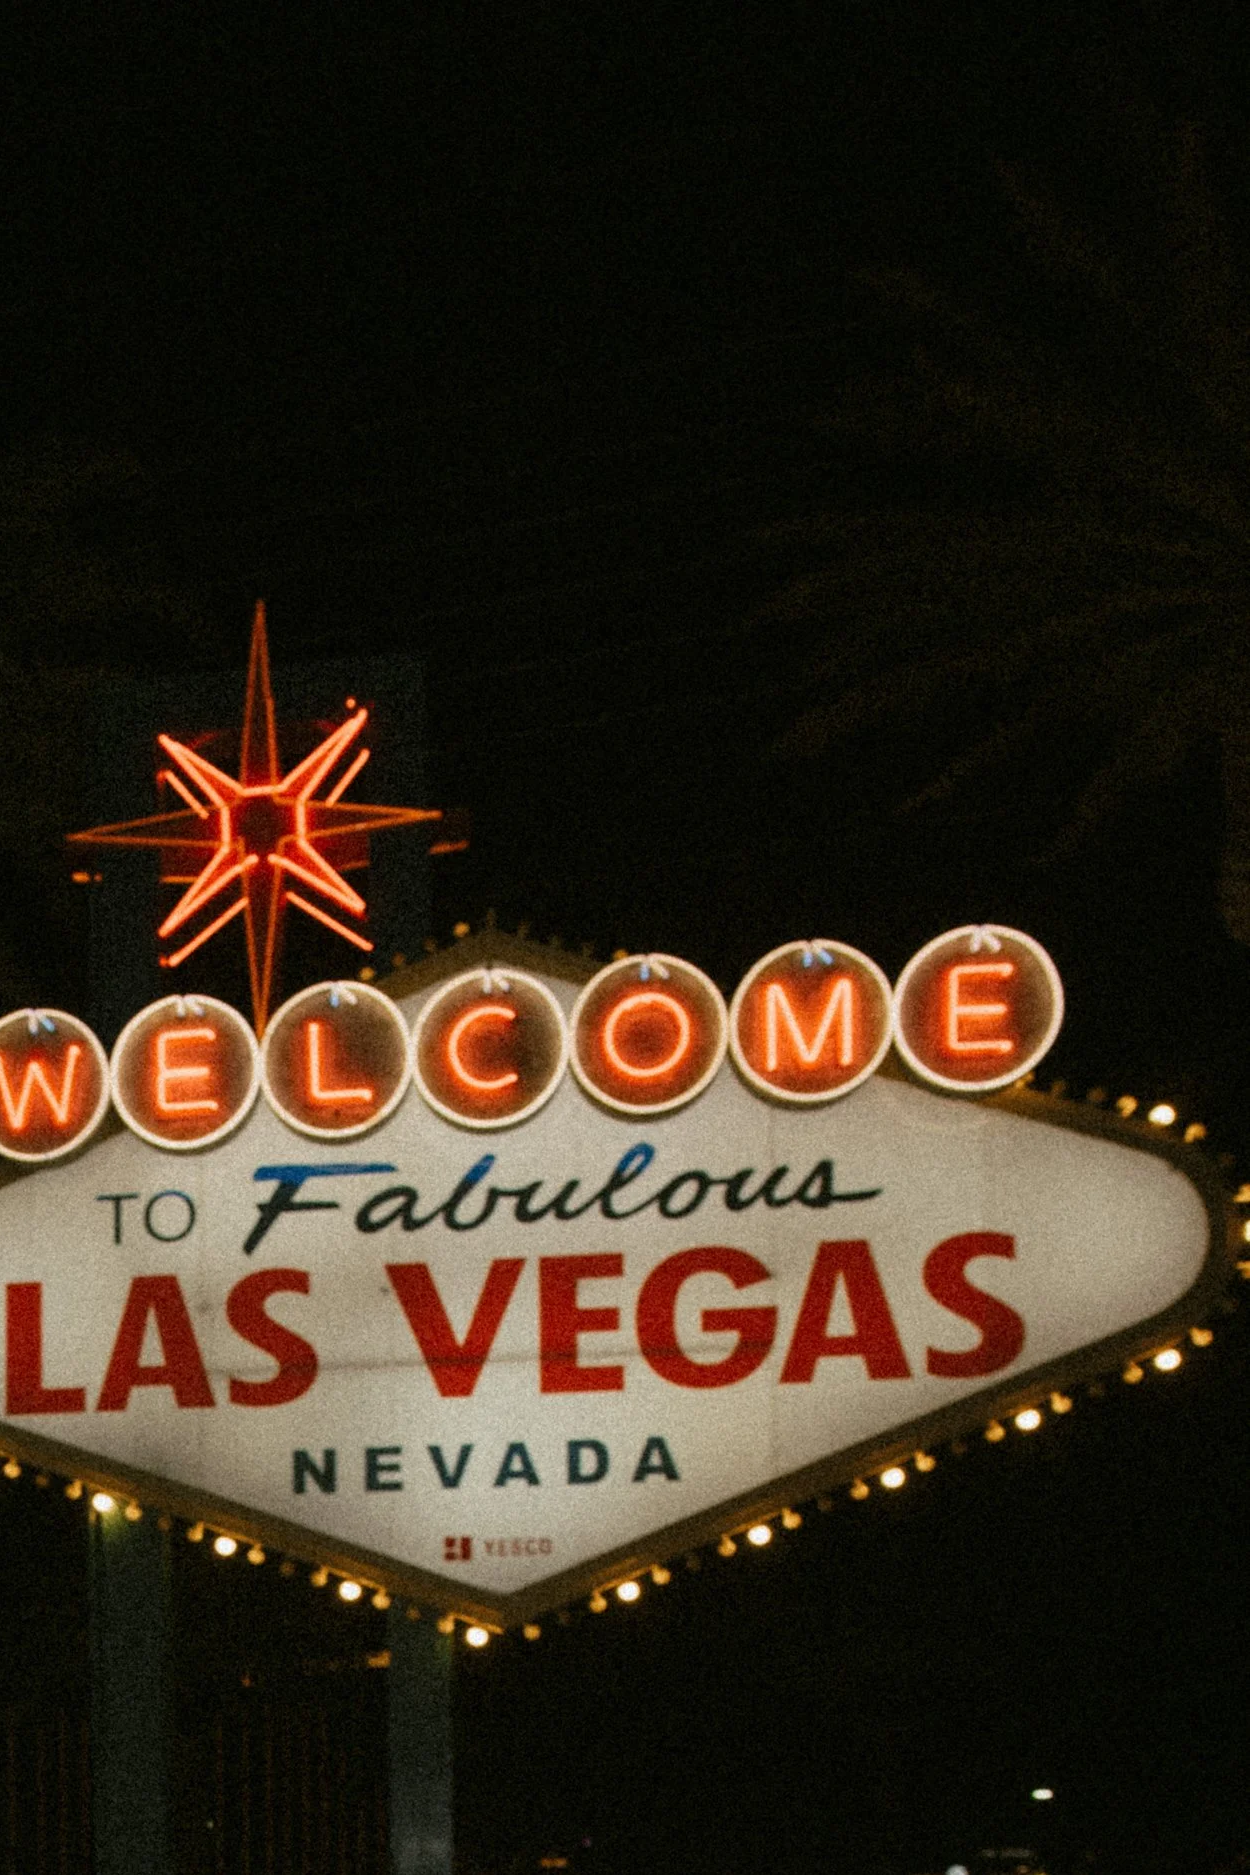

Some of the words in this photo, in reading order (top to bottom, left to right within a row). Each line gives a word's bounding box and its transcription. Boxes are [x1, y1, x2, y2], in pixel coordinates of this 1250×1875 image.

[96, 1188, 197, 1246] TO
[242, 1141, 884, 1255] Fabulous
[4, 1267, 320, 1417] LAS
[383, 1230, 1027, 1399] VEGAS
[292, 1435, 683, 1494] NEVADA
